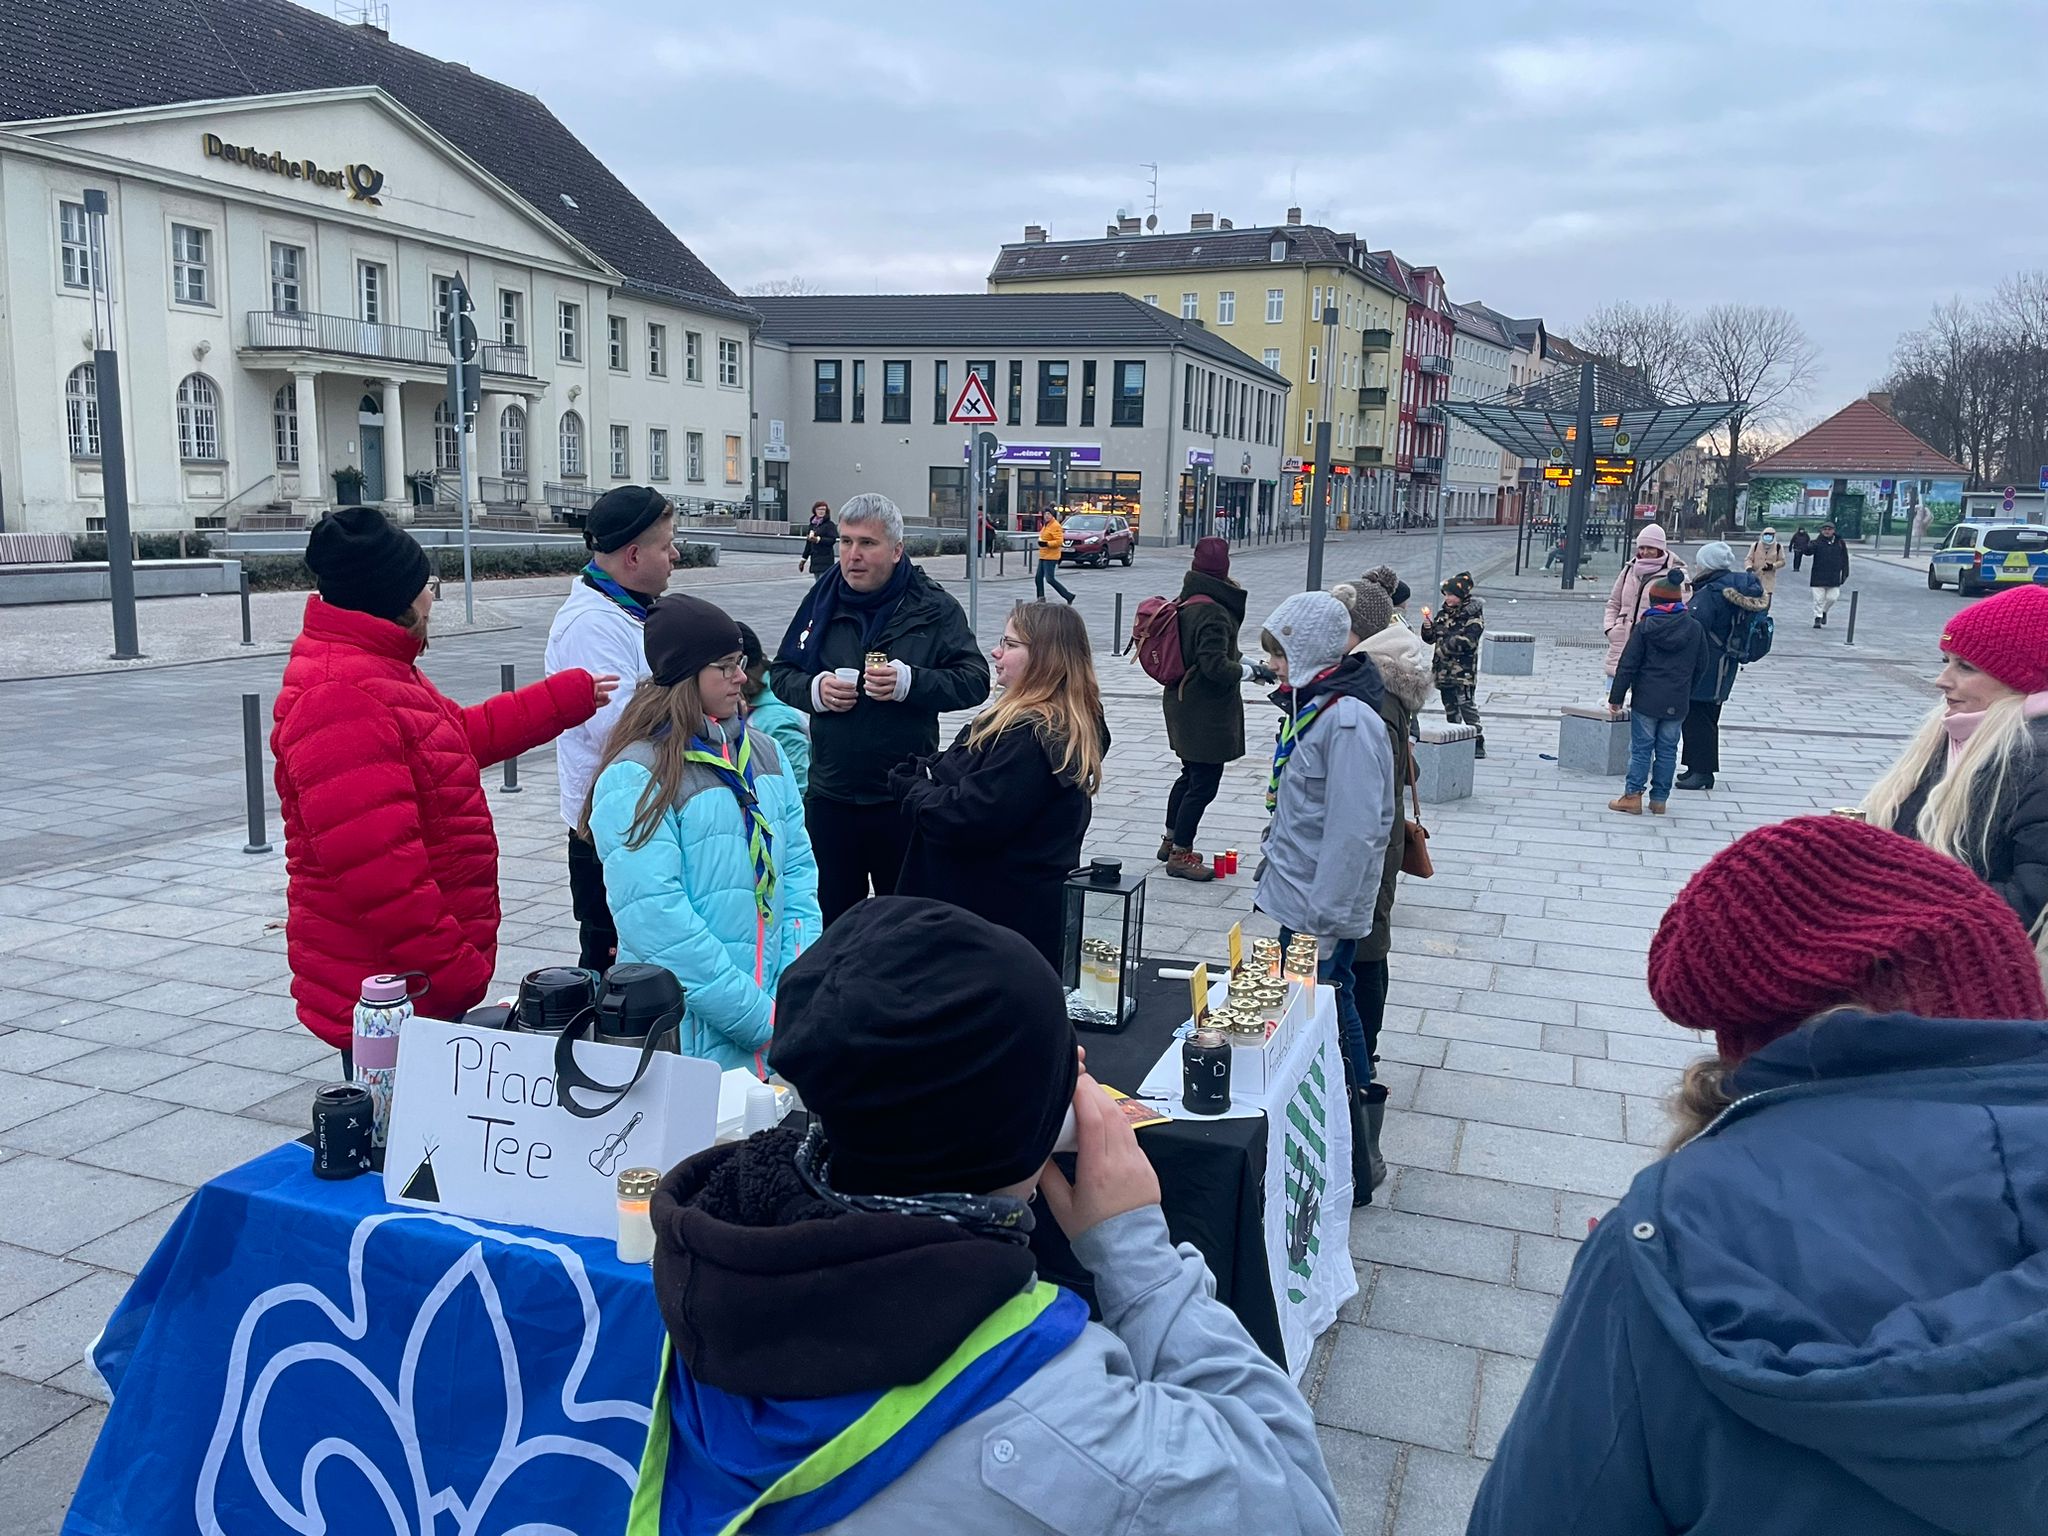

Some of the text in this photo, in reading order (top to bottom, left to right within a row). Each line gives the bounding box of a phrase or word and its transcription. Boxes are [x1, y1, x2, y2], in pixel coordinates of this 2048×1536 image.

[203, 133, 345, 190] Deutsche Post
[1286, 458, 1299, 466] dm
[467, 1115, 551, 1178] Tee
